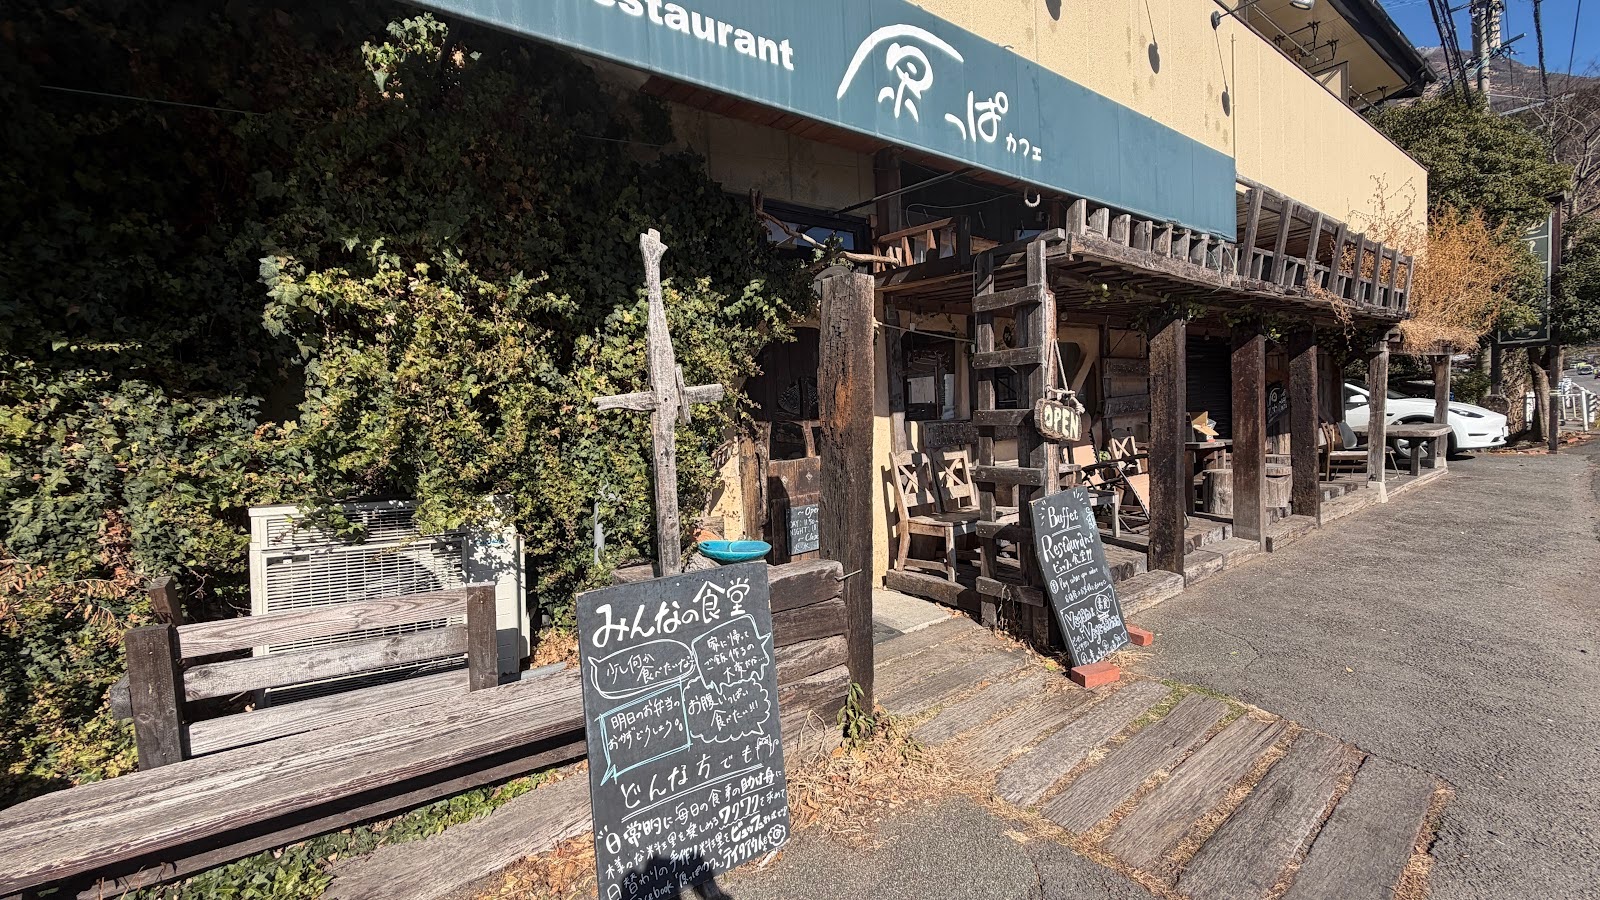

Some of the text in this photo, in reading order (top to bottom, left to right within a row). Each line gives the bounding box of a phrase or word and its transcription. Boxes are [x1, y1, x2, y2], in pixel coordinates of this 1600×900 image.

[597, 0, 795, 71] staurant
[1005, 132, 1042, 162] カフェ
[1044, 404, 1079, 439] OPEN
[1047, 506, 1079, 529] Buffet
[1041, 532, 1094, 563] Restaurant
[592, 577, 751, 648] みんなの食堂
[706, 629, 750, 653] 家に帰って
[606, 653, 655, 684] 少し何か
[703, 643, 755, 671] ご飯作るの
[610, 695, 680, 732] 明日のお弁当の
[688, 687, 749, 715] お腹いっぱい
[620, 744, 753, 809] どんな方でも
